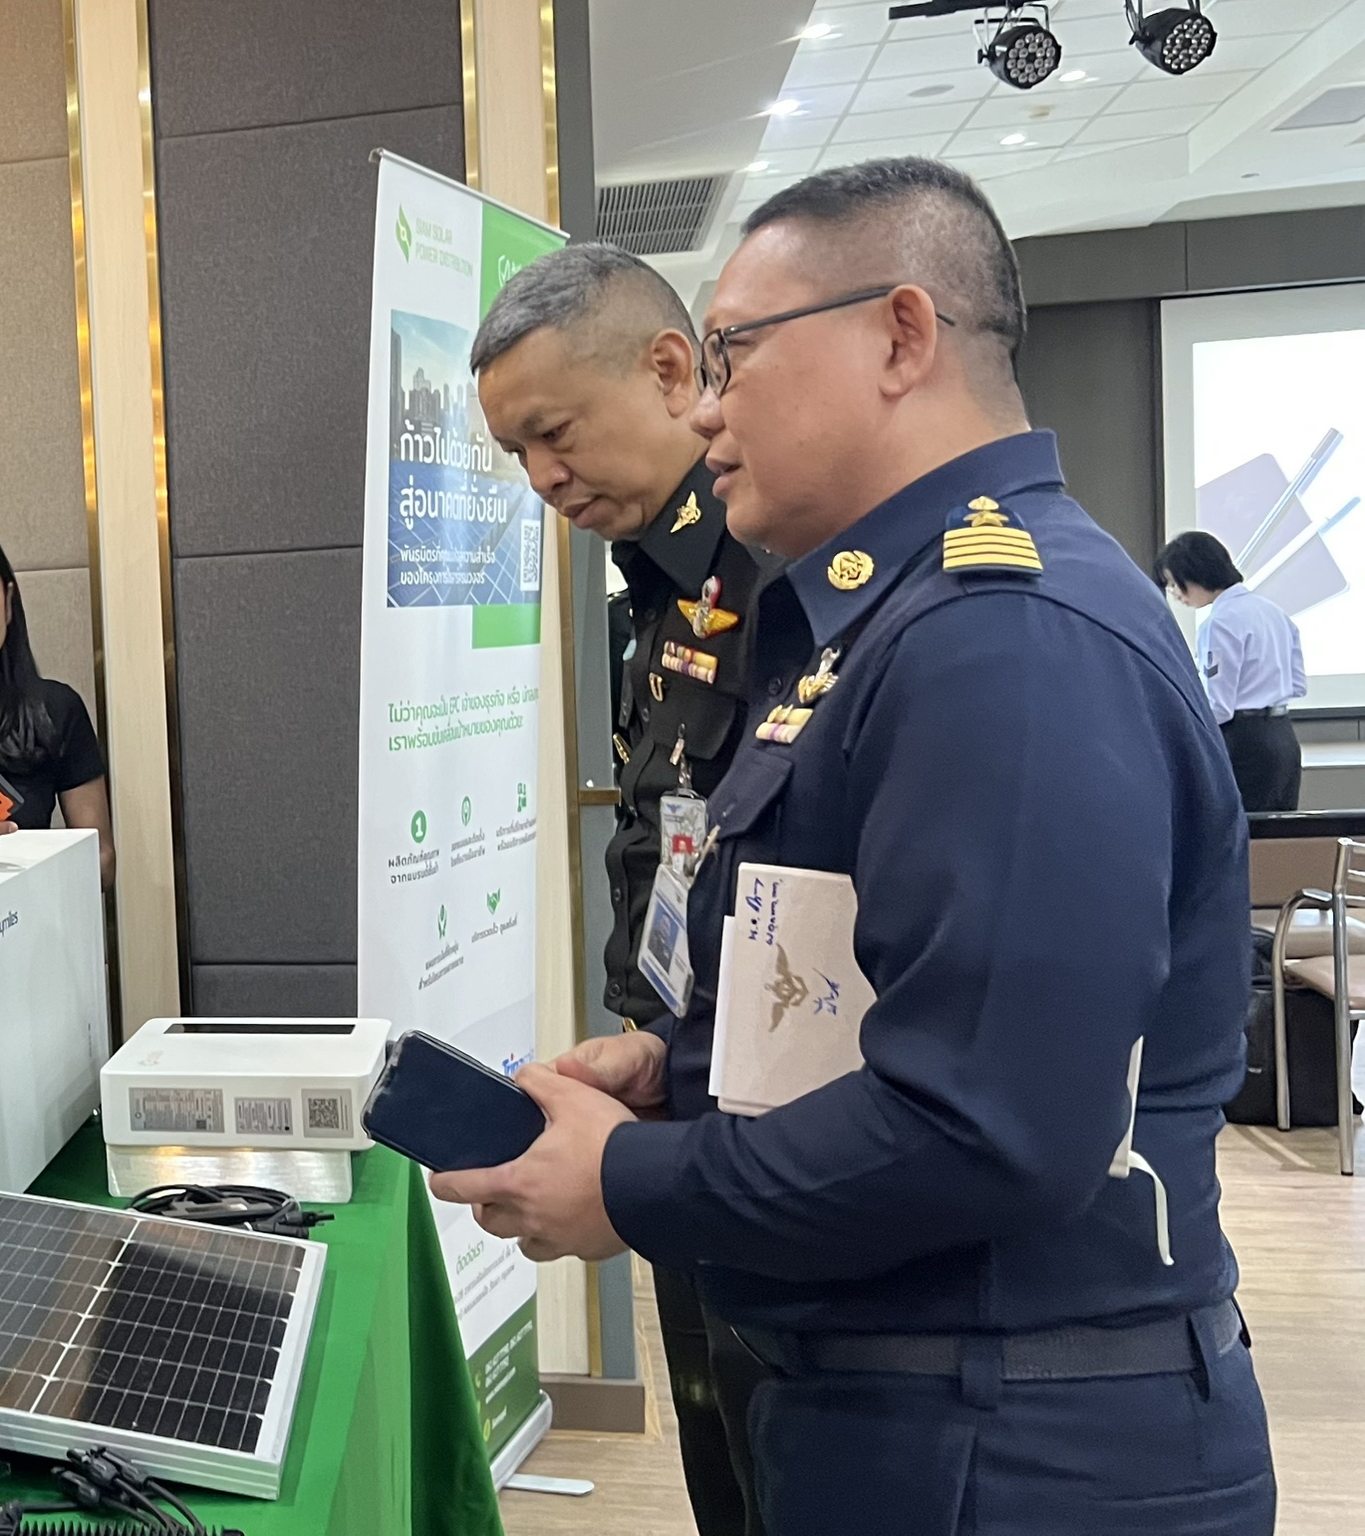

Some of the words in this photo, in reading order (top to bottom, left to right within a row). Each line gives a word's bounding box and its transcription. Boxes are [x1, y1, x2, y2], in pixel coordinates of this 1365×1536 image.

[400, 419, 493, 472] ก้าวไปด้วยกัน
[399, 475, 508, 530] สู่อนาคตที่ยั่งยืน
